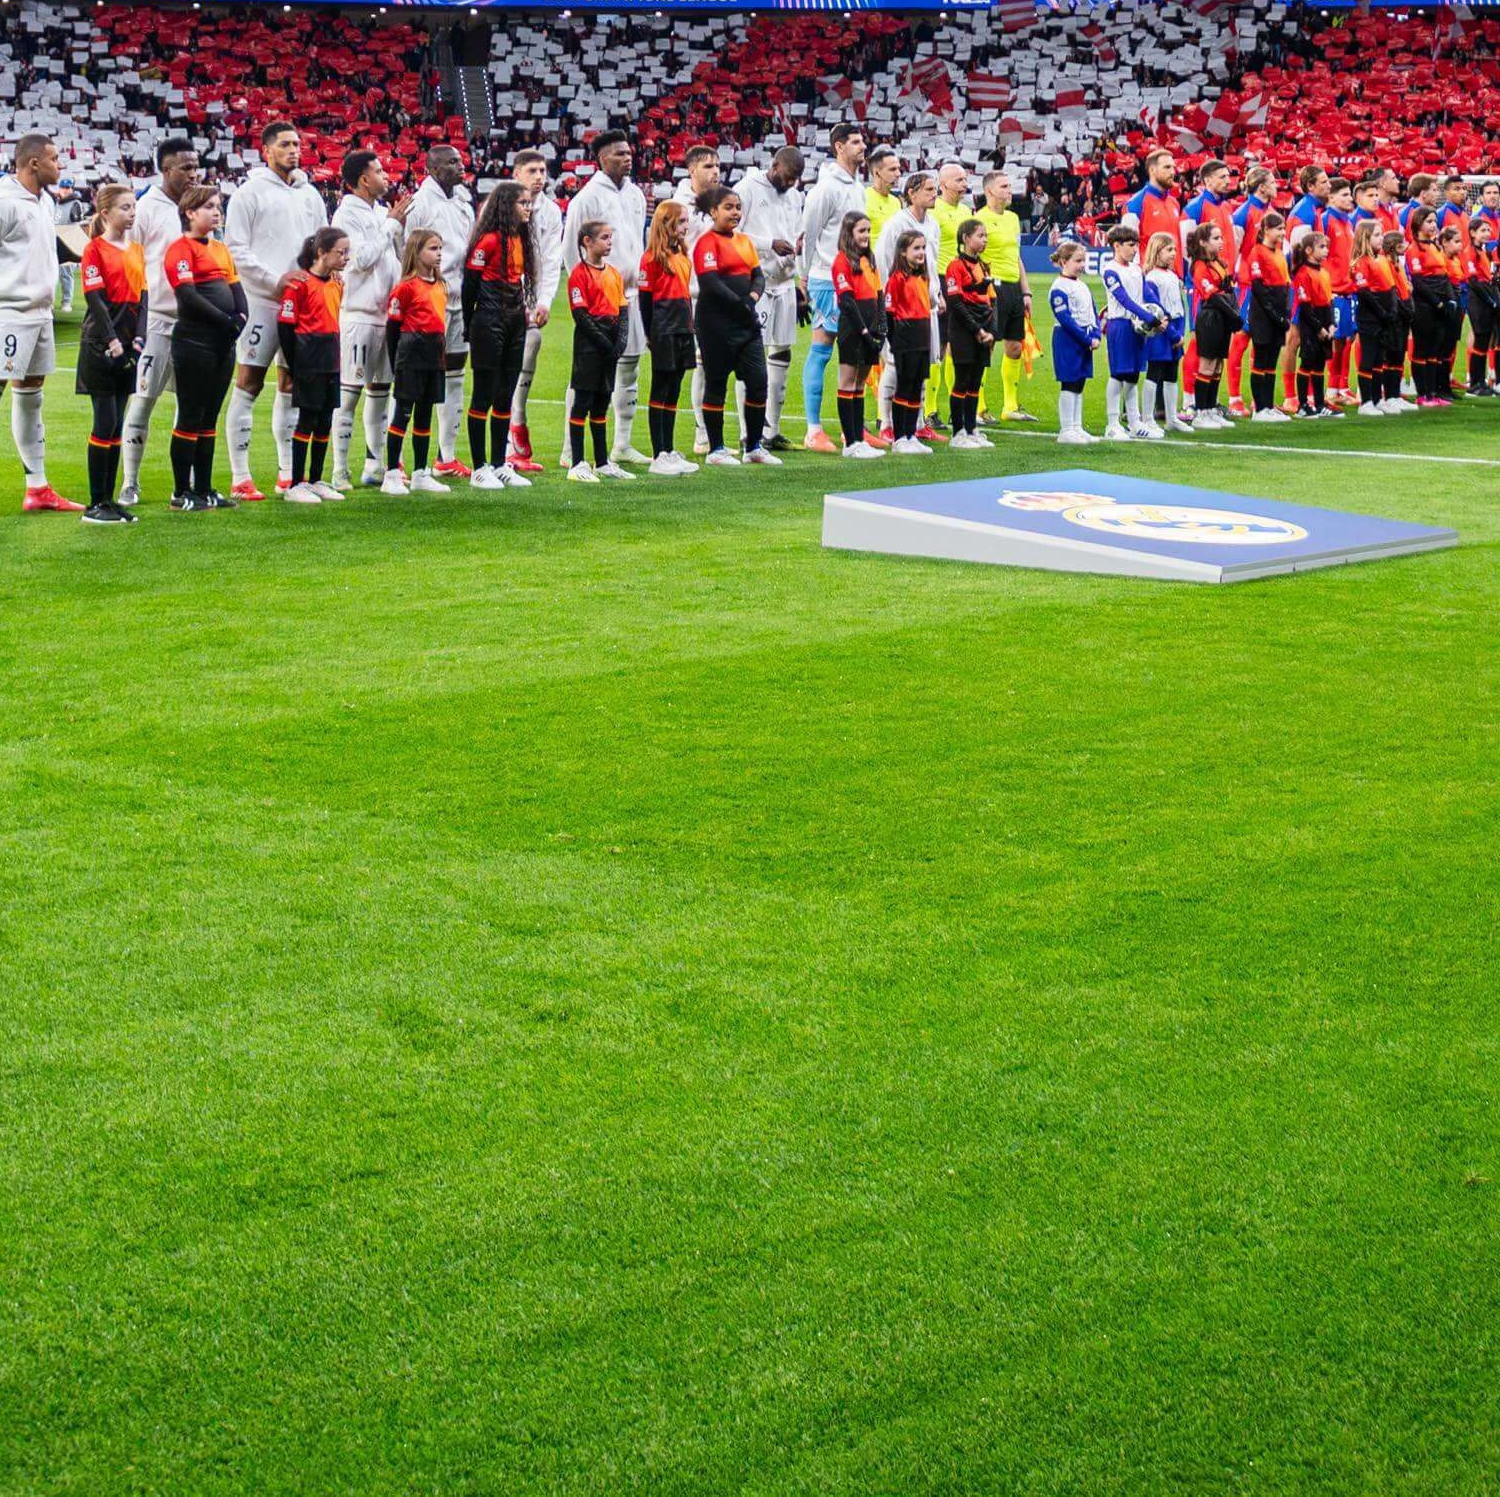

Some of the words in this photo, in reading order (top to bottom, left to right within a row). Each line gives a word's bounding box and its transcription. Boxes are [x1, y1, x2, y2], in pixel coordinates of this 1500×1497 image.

[3, 333, 18, 358] 9
[248, 324, 264, 346] 5
[141, 354, 154, 377] 7
[352, 343, 367, 366] 11
